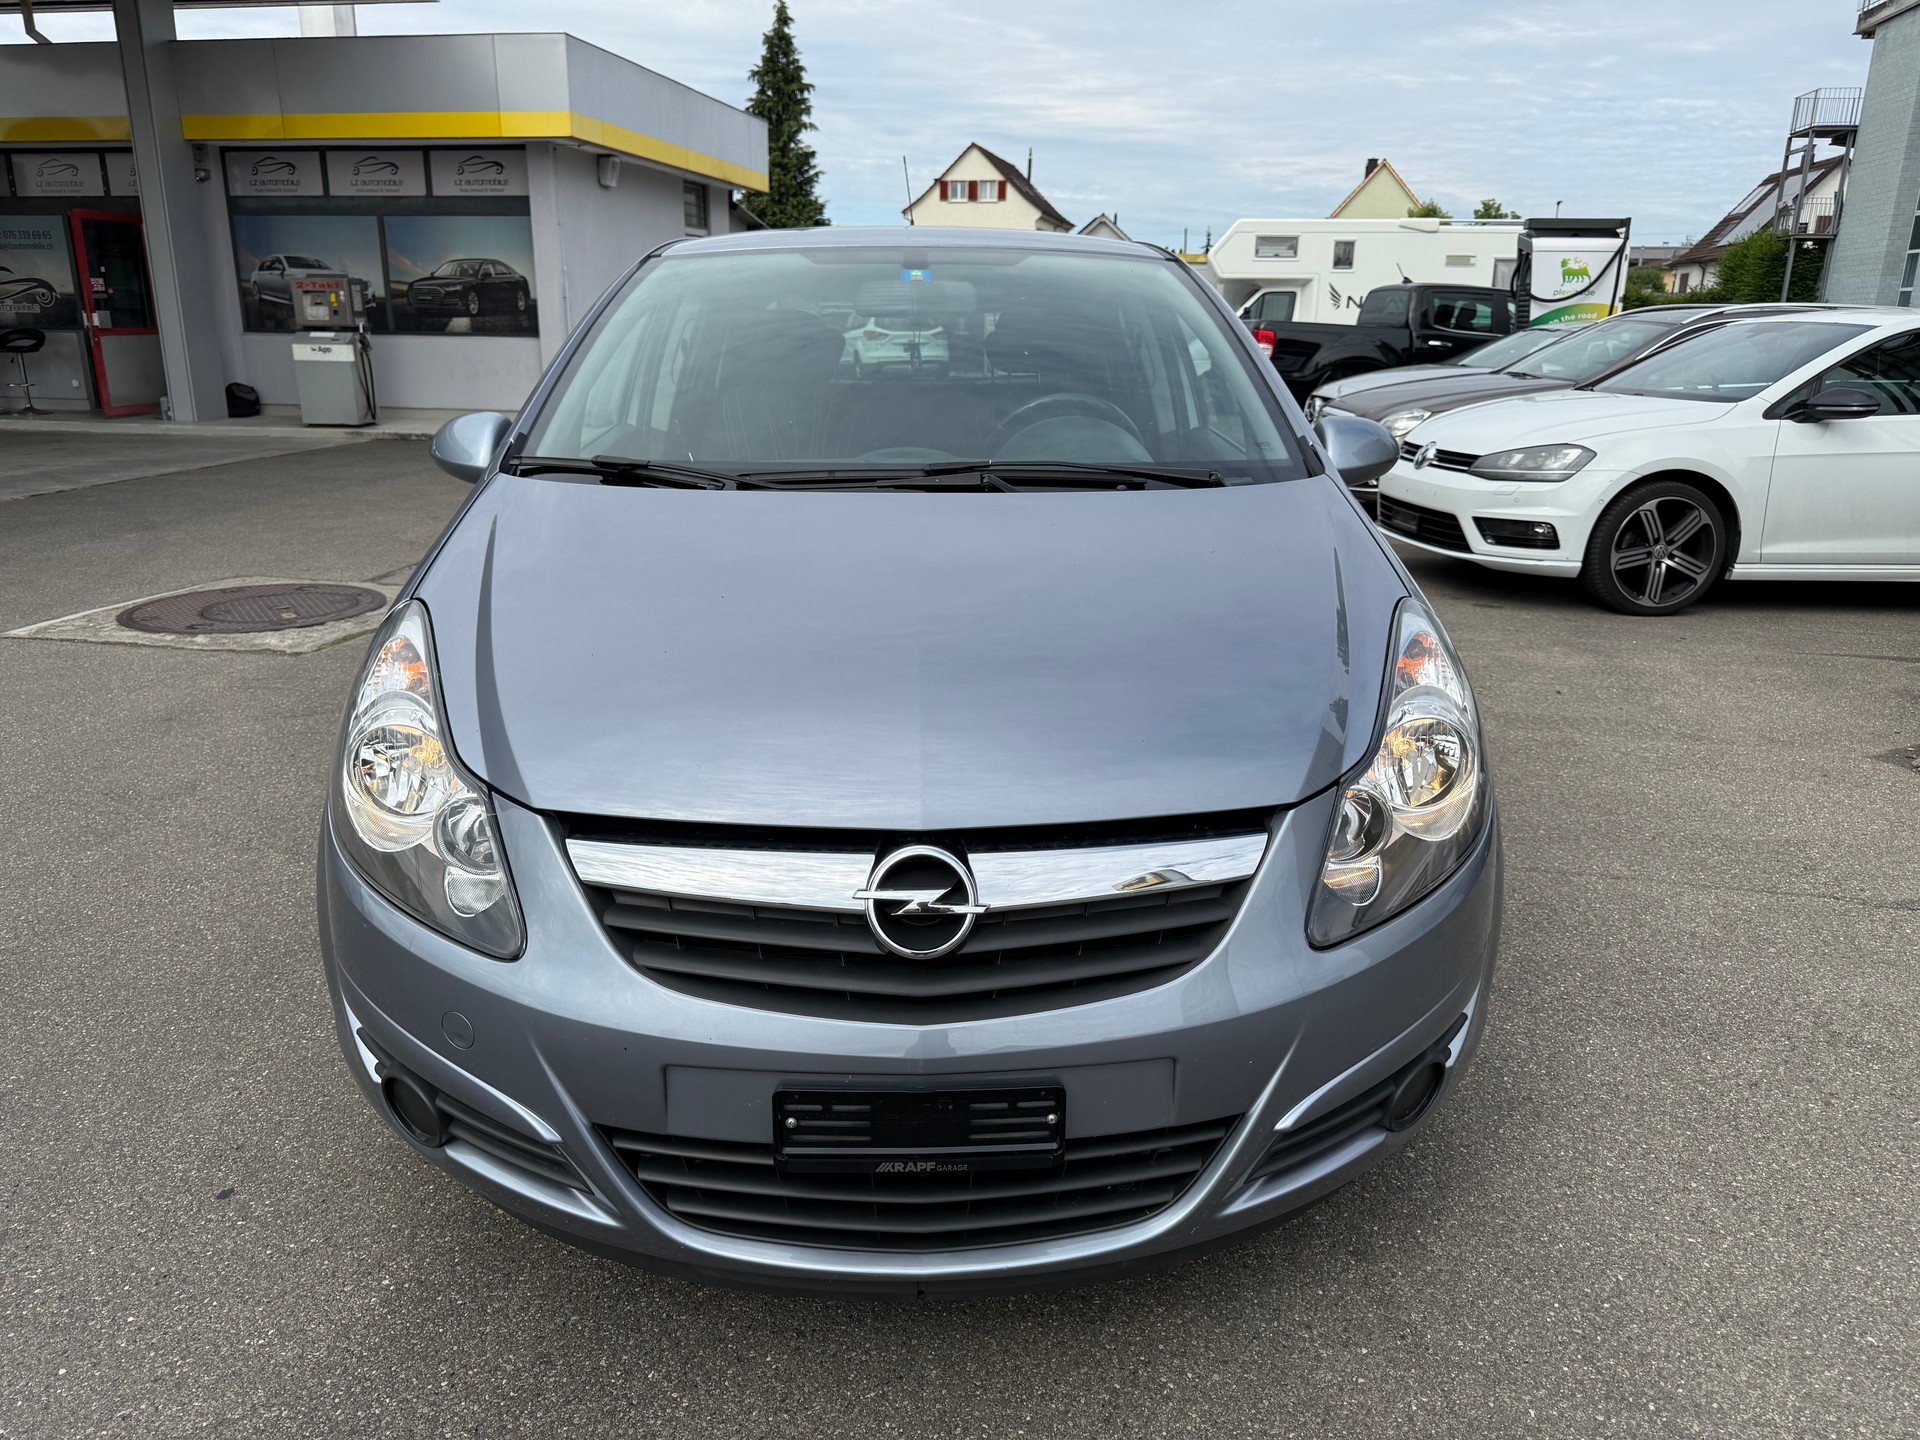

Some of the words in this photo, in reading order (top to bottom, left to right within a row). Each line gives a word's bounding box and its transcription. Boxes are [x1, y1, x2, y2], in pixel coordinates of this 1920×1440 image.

[3, 230, 17, 240] 076
[17, 230, 31, 240] 339
[32, 230, 41, 240] 69
[42, 230, 52, 240] 65
[295, 280, 341, 289] 2-Takt
[1552, 288, 1596, 297] plenitde
[1561, 313, 1576, 323] the
[1577, 312, 1598, 320] road
[877, 1161, 936, 1173] KRAPF
[937, 1164, 968, 1172] GARAGE
